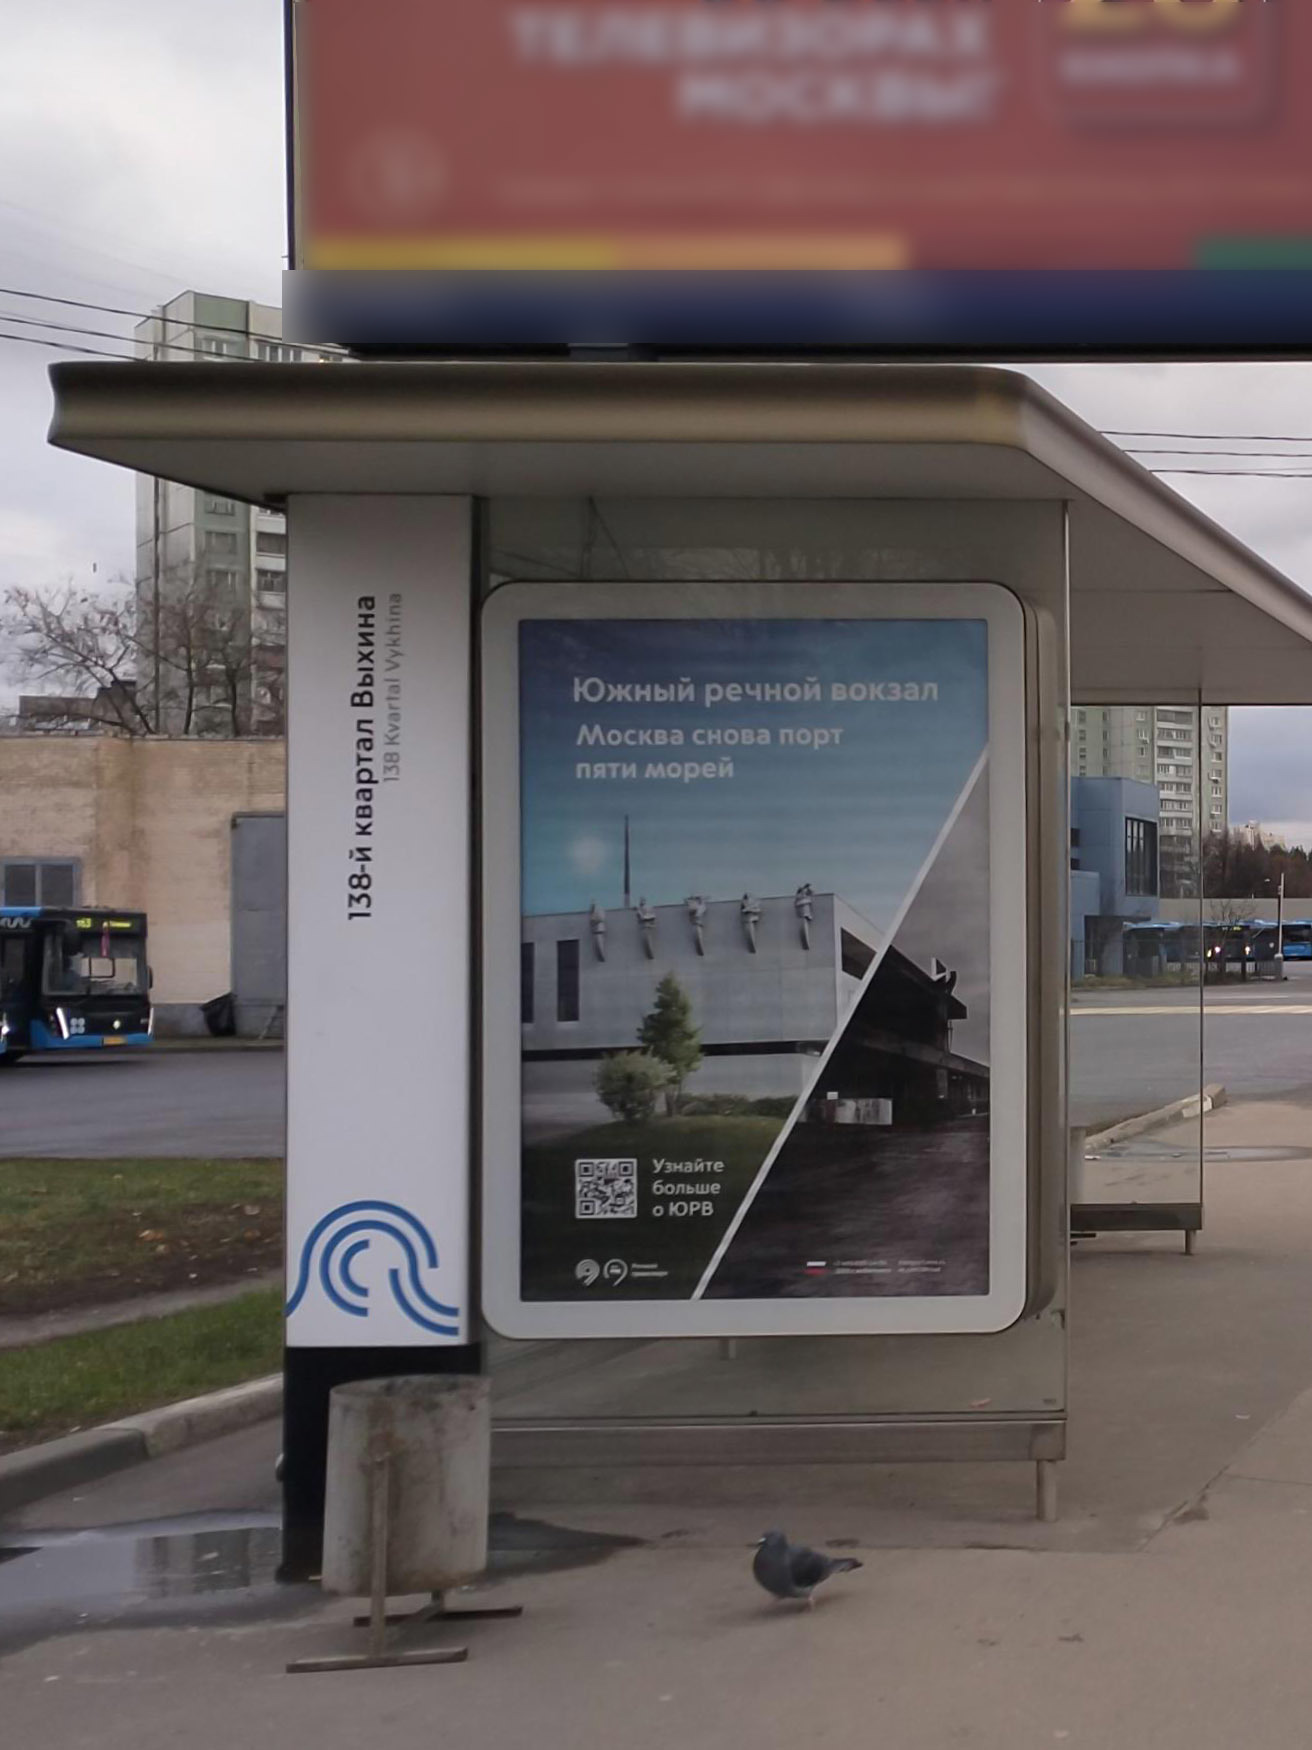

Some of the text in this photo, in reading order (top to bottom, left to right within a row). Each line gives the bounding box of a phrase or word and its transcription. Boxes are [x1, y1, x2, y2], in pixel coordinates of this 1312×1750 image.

[383, 592, 406, 782] 138 Kvartal Vykhina
[572, 676, 939, 707] Южный речной вокзал
[576, 724, 844, 750] Москва снова порт
[347, 595, 379, 920] 138-й квартал Выхина
[575, 757, 735, 783] пяти морей
[652, 1158, 725, 1174] Узнайте
[652, 1180, 721, 1195] больше
[652, 1201, 714, 1217] о ЮРВ
